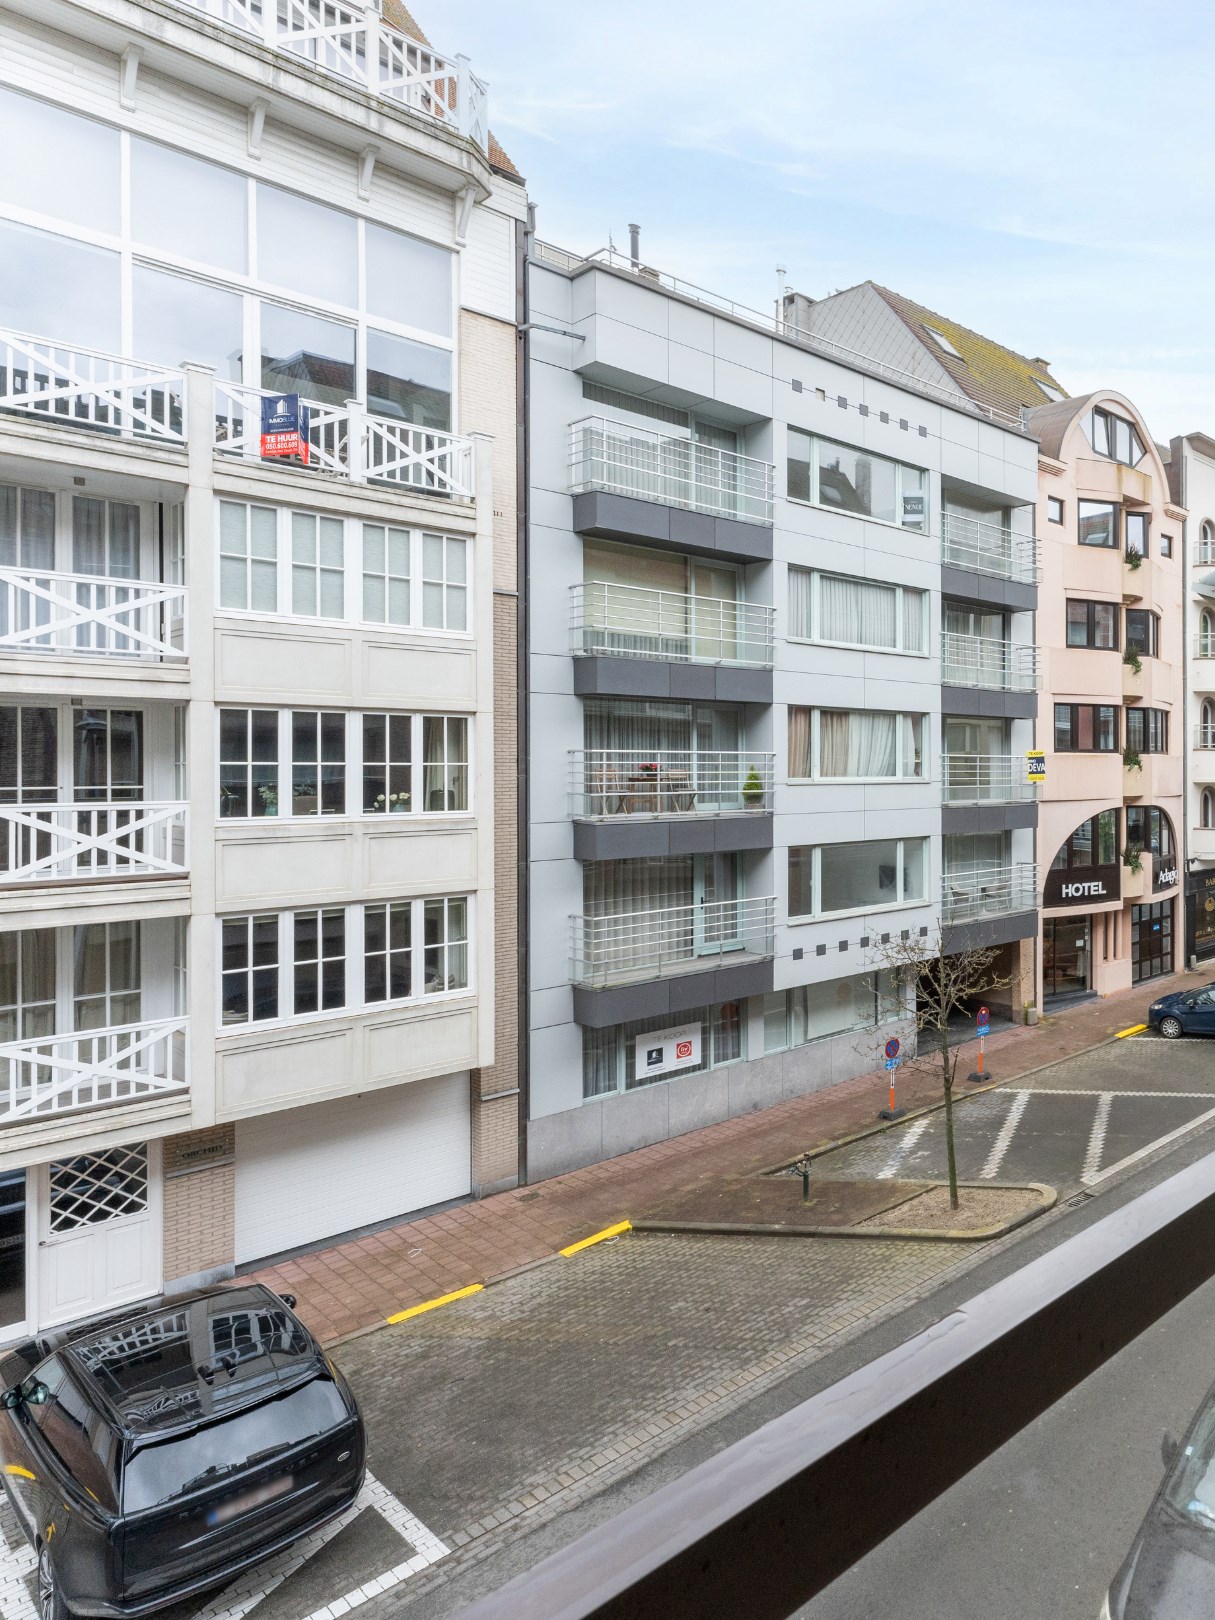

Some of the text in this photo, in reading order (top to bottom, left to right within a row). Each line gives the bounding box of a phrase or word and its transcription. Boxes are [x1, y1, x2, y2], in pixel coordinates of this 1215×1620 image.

[278, 434, 298, 442] HUUR
[1158, 866, 1178, 884] Adagio
[1062, 882, 1107, 898] HOTEL
[664, 1030, 687, 1040] KOOP
[182, 1145, 223, 1158] ORCHID
